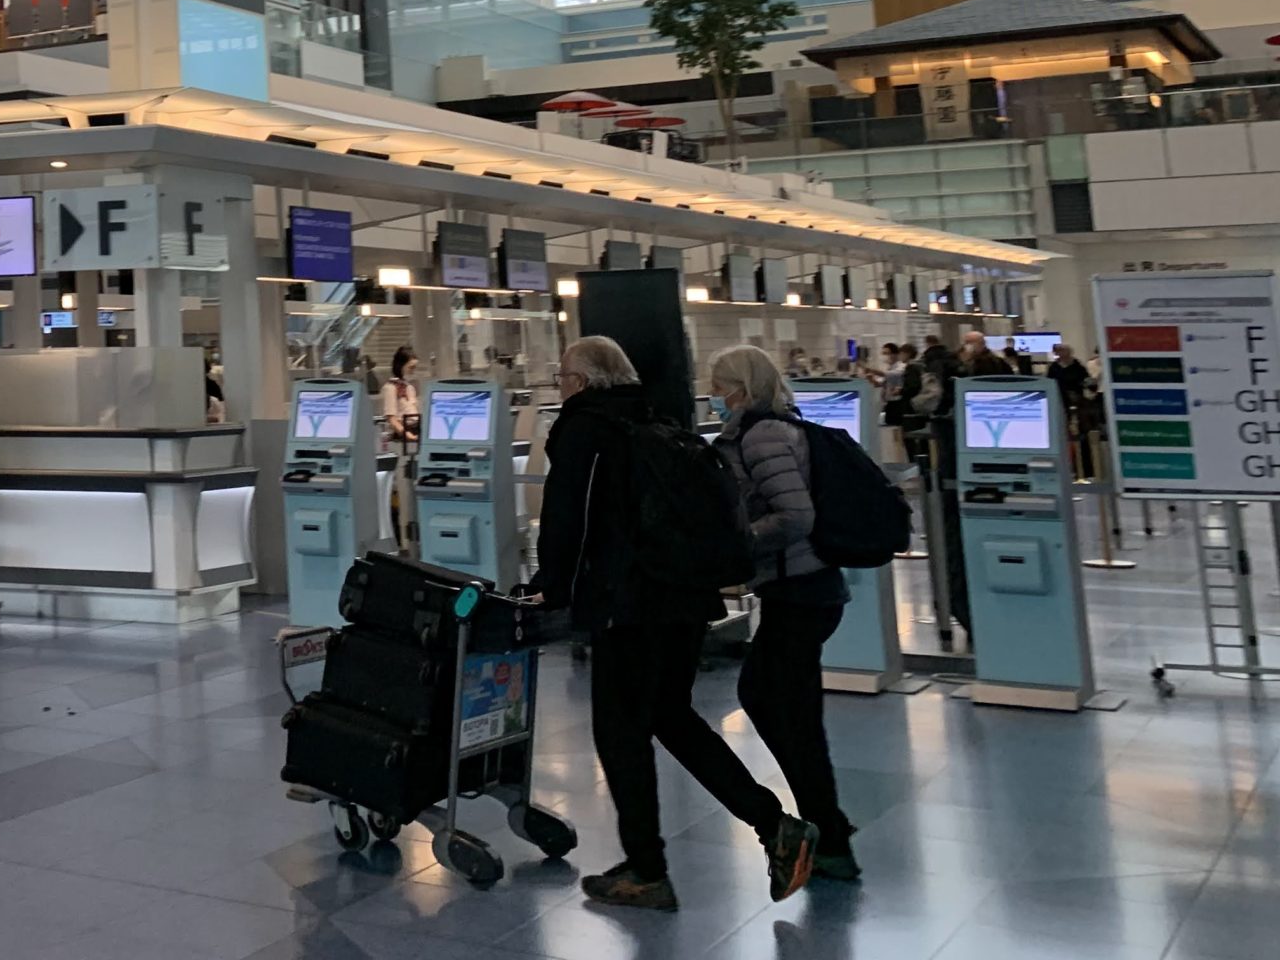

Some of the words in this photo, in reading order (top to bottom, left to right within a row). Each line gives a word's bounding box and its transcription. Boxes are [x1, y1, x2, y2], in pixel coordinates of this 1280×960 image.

[98, 200, 127, 256] F
[184, 201, 203, 256] F
[1245, 326, 1265, 353] F
[1249, 358, 1268, 385] F
